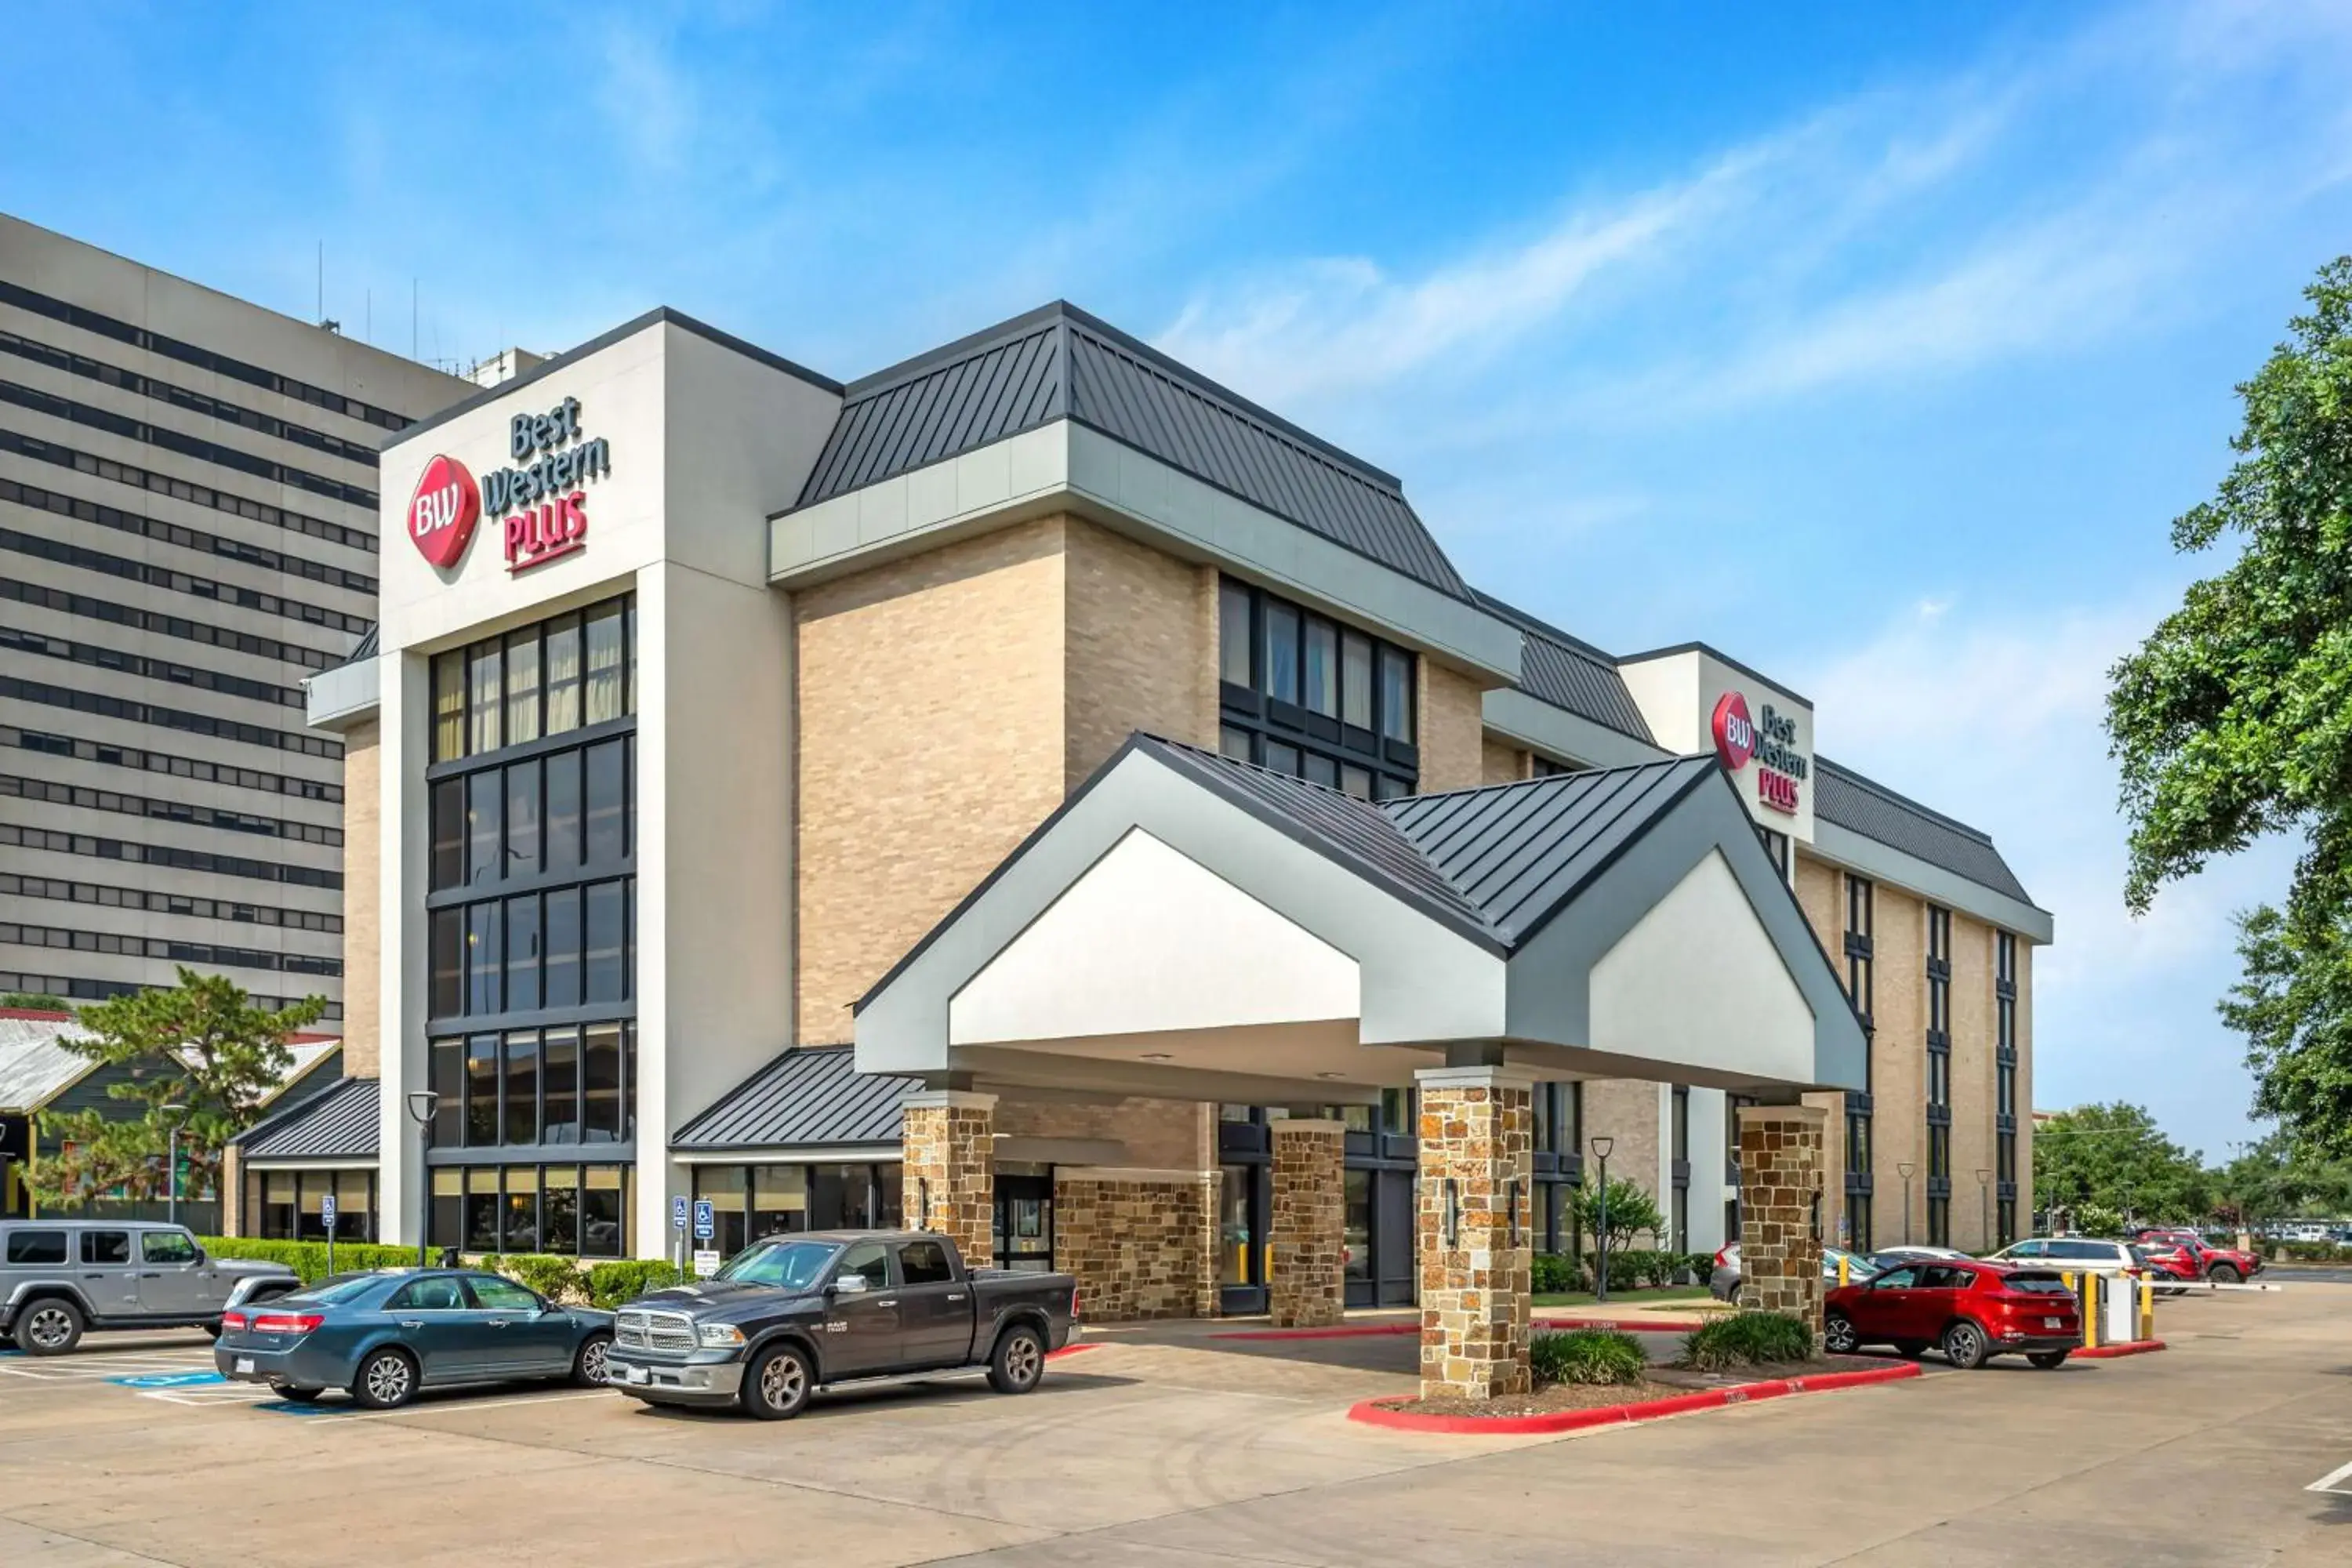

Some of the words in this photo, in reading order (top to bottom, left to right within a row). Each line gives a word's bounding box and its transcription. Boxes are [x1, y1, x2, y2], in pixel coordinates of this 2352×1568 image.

[510, 396, 583, 459] Best
[481, 437, 610, 517] Western
[416, 482, 459, 537] BW
[504, 491, 586, 561] PLUS
[1727, 713, 1751, 749] BW
[1762, 704, 1796, 745] Best
[1754, 730, 1807, 779] Western
[1759, 768, 1799, 808] PLUS
